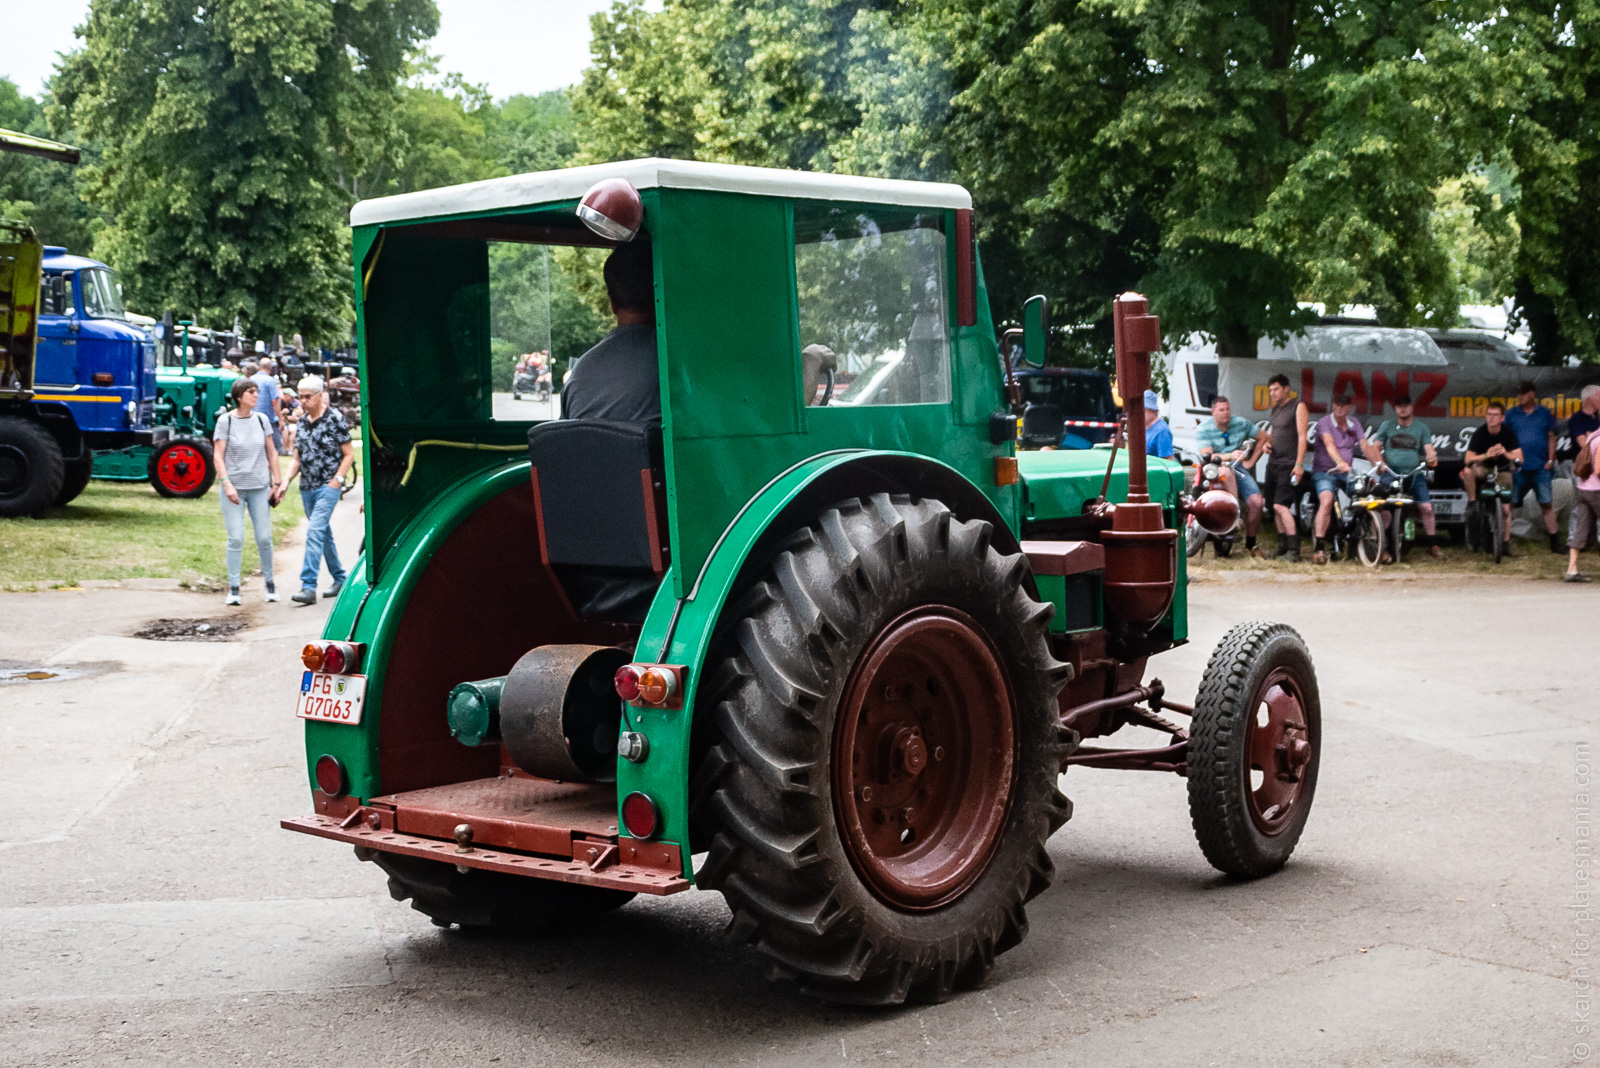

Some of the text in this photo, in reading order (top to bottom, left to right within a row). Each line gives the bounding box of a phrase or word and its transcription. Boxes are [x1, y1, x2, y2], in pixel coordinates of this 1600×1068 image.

[1302, 368, 1448, 417] LANZ
[312, 675, 332, 694] FG
[305, 696, 352, 719] 07063
